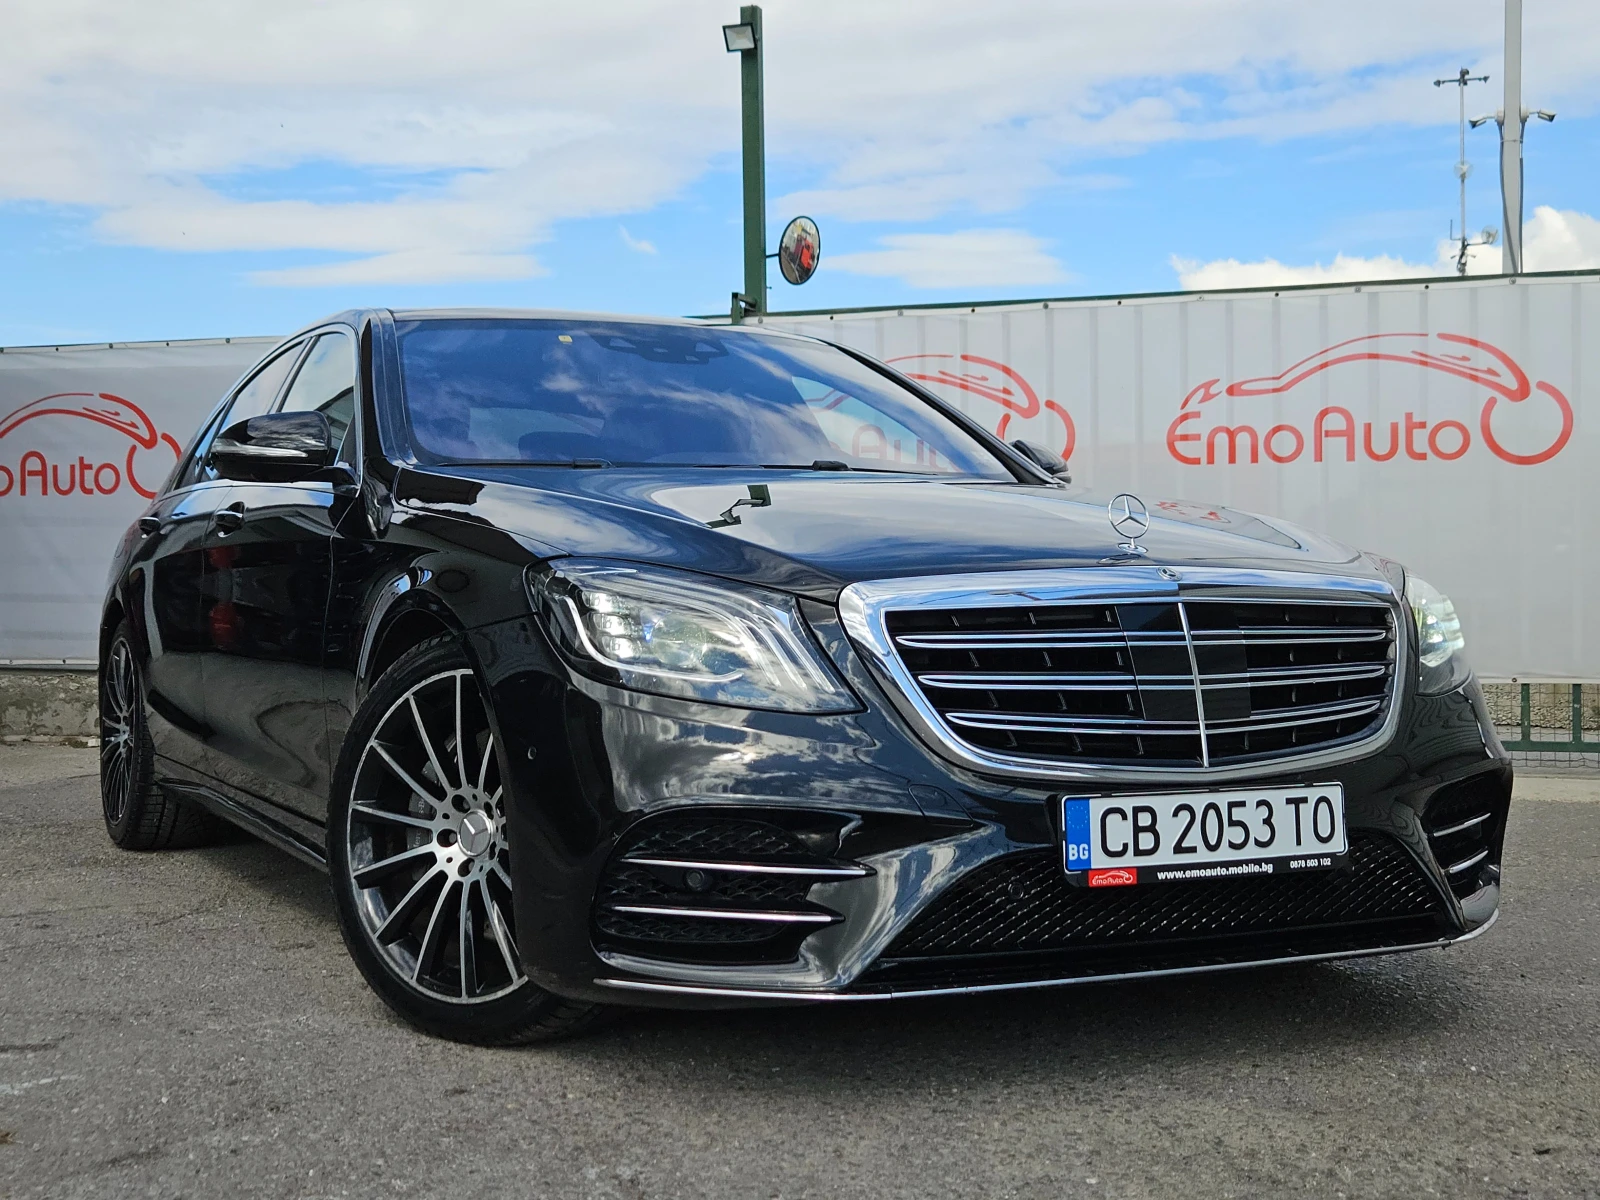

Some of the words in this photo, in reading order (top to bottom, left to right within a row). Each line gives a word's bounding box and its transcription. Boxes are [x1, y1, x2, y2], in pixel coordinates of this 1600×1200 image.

[1166, 405, 1471, 465] EmoAuto
[1100, 805, 1161, 858] CB
[1171, 799, 1276, 855] 2053
[1285, 795, 1336, 846] TO
[1068, 843, 1089, 861] BG
[1157, 862, 1273, 880] www.emoauto.mobile.bg
